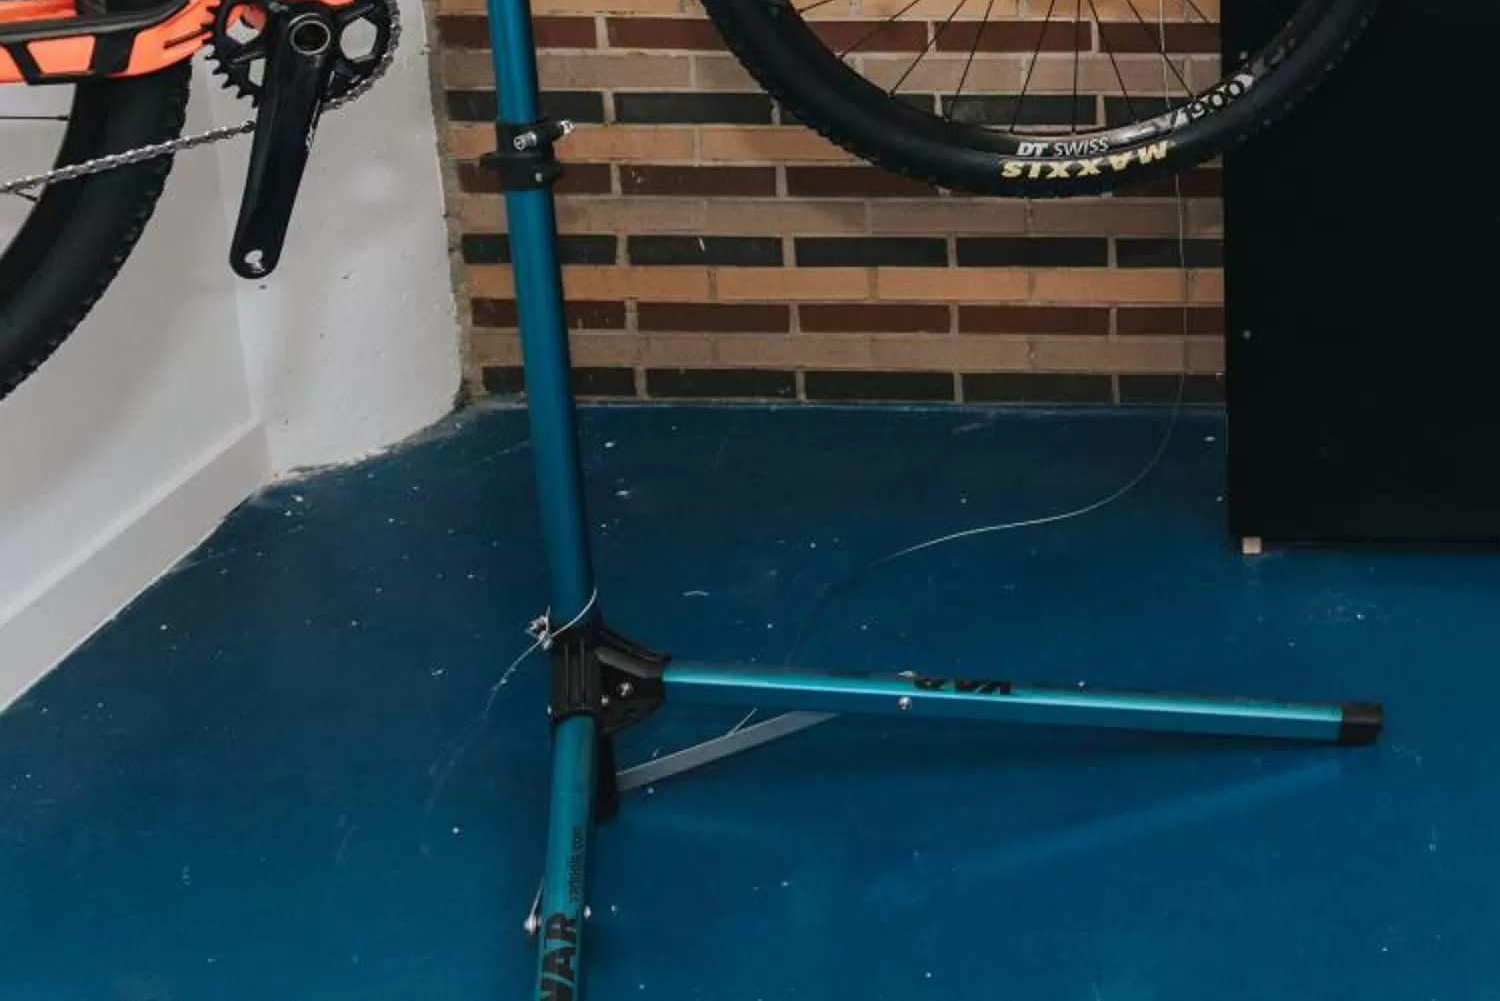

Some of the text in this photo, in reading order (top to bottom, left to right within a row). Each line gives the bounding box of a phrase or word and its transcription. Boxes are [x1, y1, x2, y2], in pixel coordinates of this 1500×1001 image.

[1001, 140, 1169, 179] MAXXIS
[1016, 137, 1110, 157] DT SWISS
